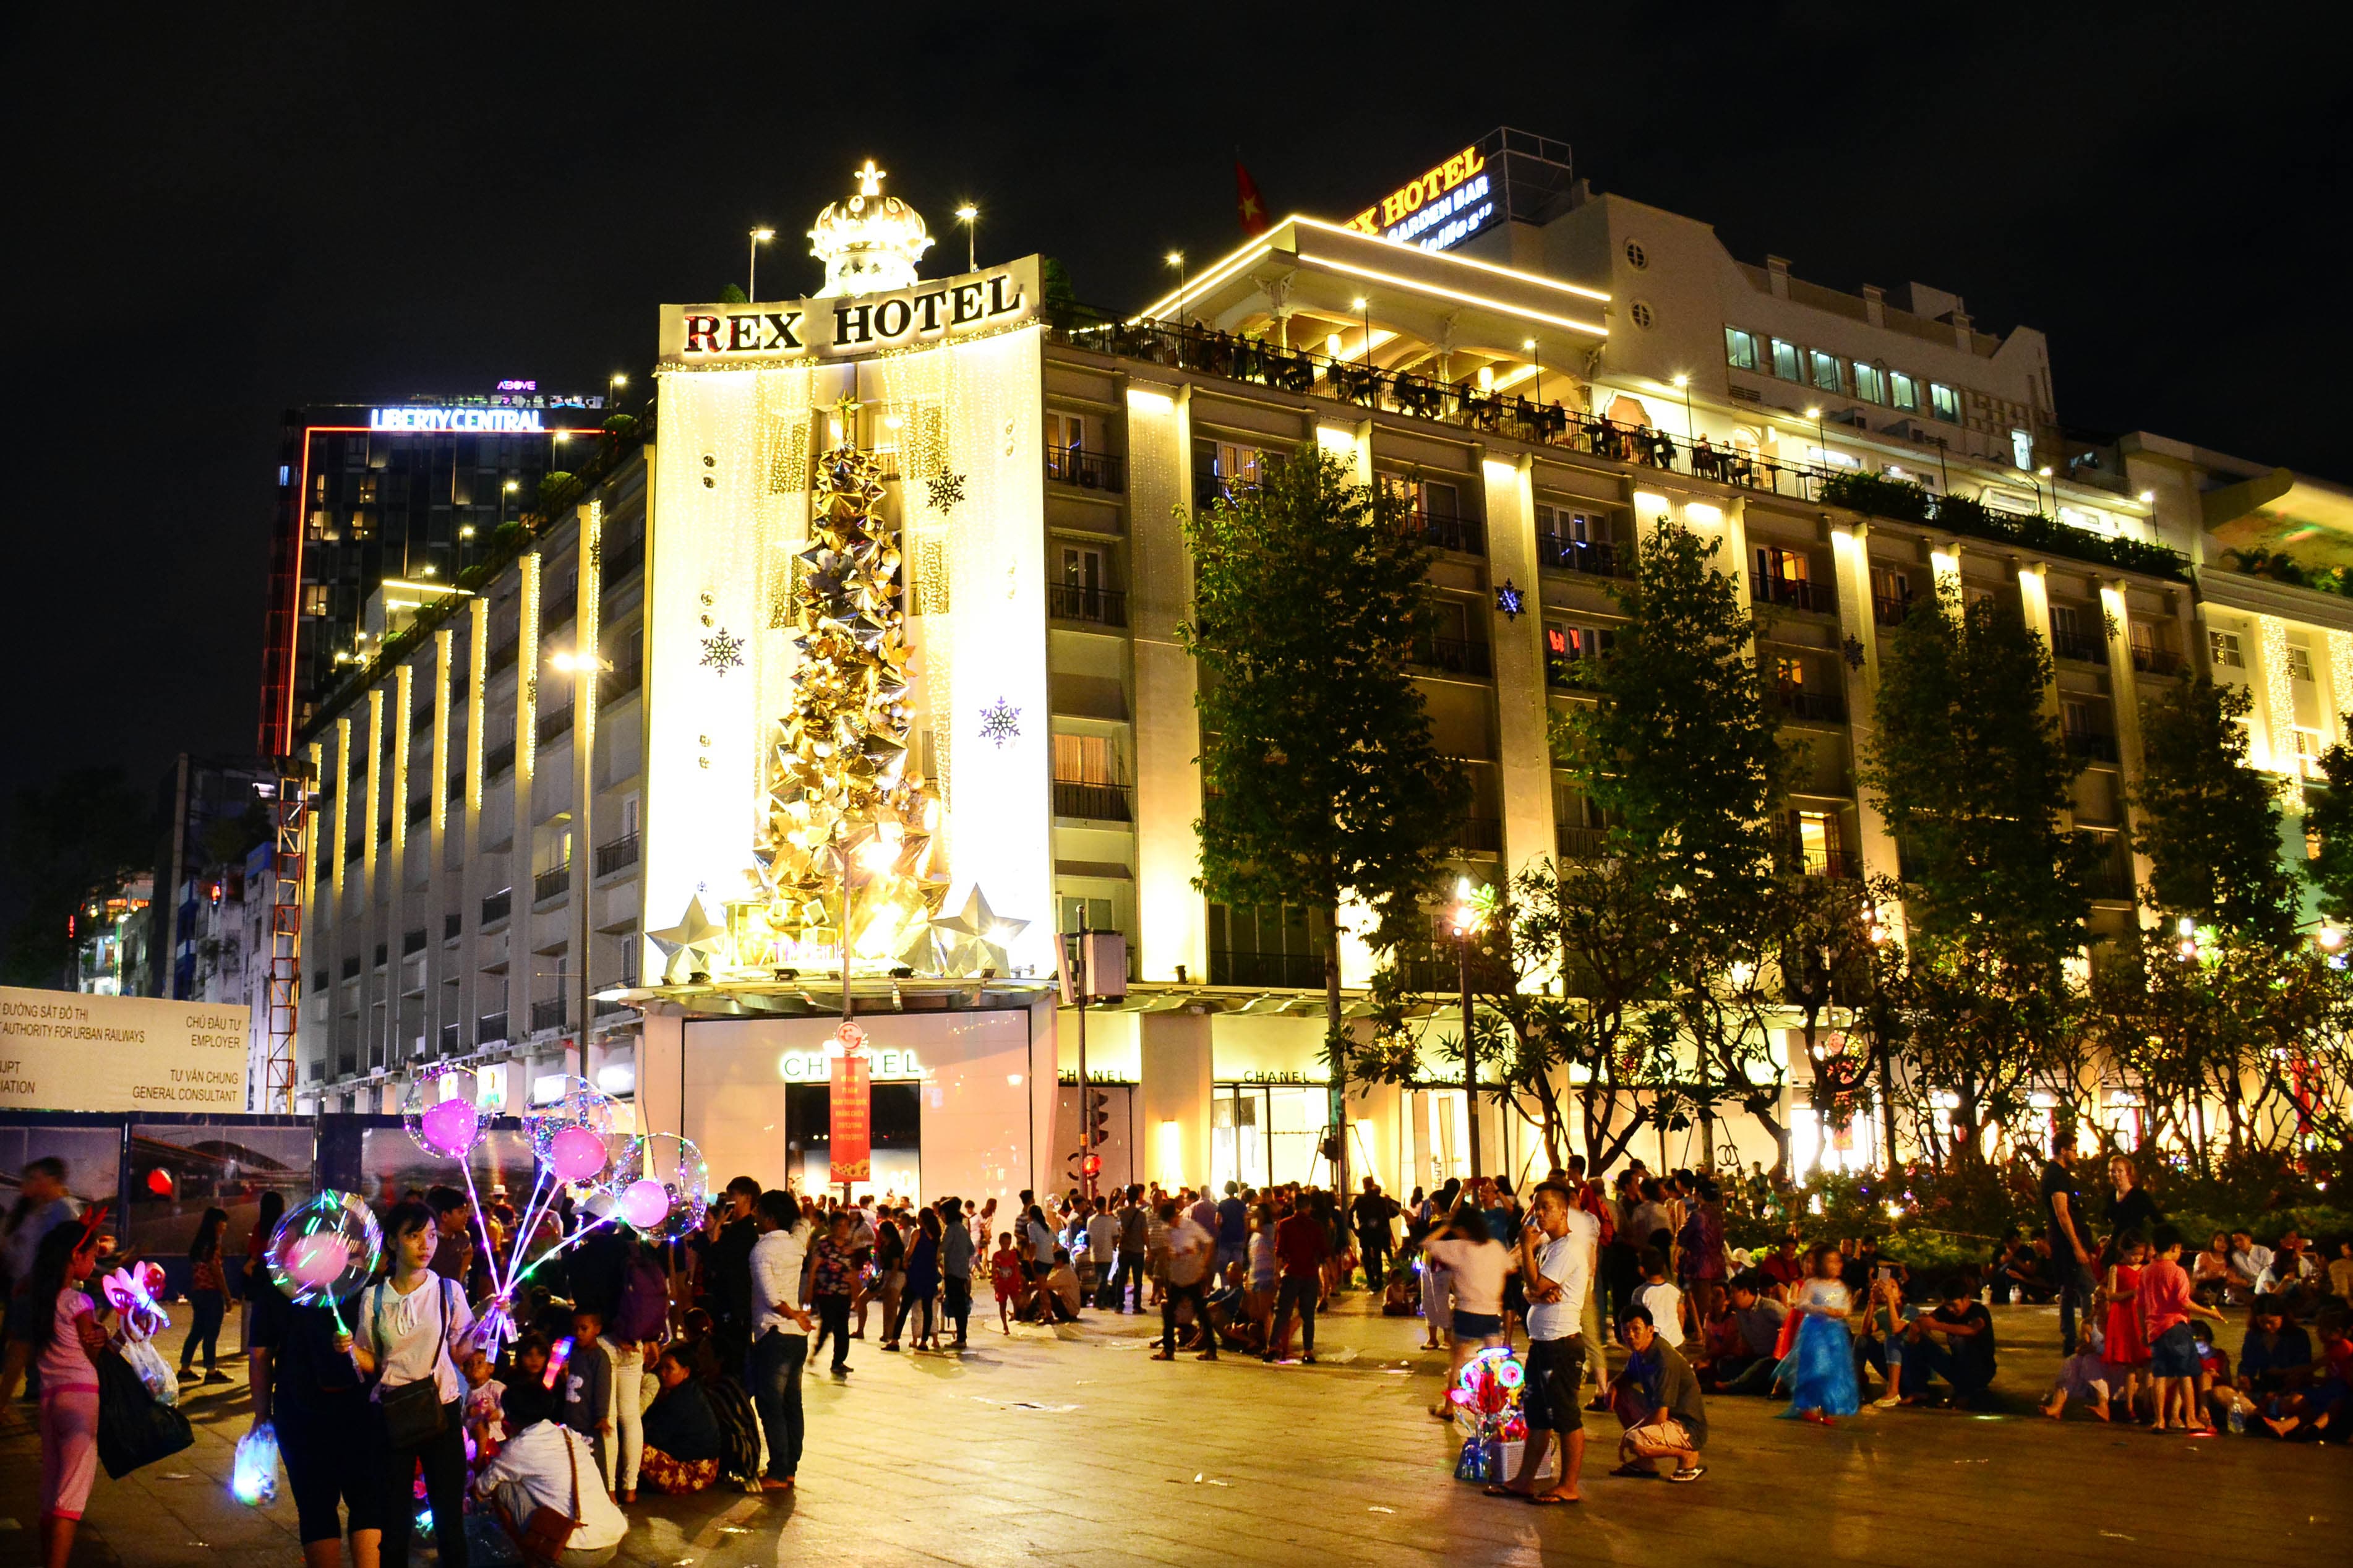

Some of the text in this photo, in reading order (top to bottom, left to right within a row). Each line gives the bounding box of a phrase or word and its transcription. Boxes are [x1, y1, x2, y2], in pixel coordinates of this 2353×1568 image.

[1382, 146, 1485, 227] HOTEL
[1386, 175, 1489, 244] GARDEN BAR
[684, 275, 1022, 353] REX HOTEL
[497, 380, 536, 391] ABOVE
[371, 408, 544, 432] LIBERTY CENTRAL
[3, 1022, 145, 1043] AUTHORITY FOR URBAN RAILWAYS
[191, 1034, 240, 1048] EMPLOYER
[785, 1054, 919, 1076] CHEL
[206, 1071, 238, 1084] CHUNG
[1244, 1070, 1311, 1083] CHANEL
[132, 1086, 237, 1102] GENERAL CONSULTANT
